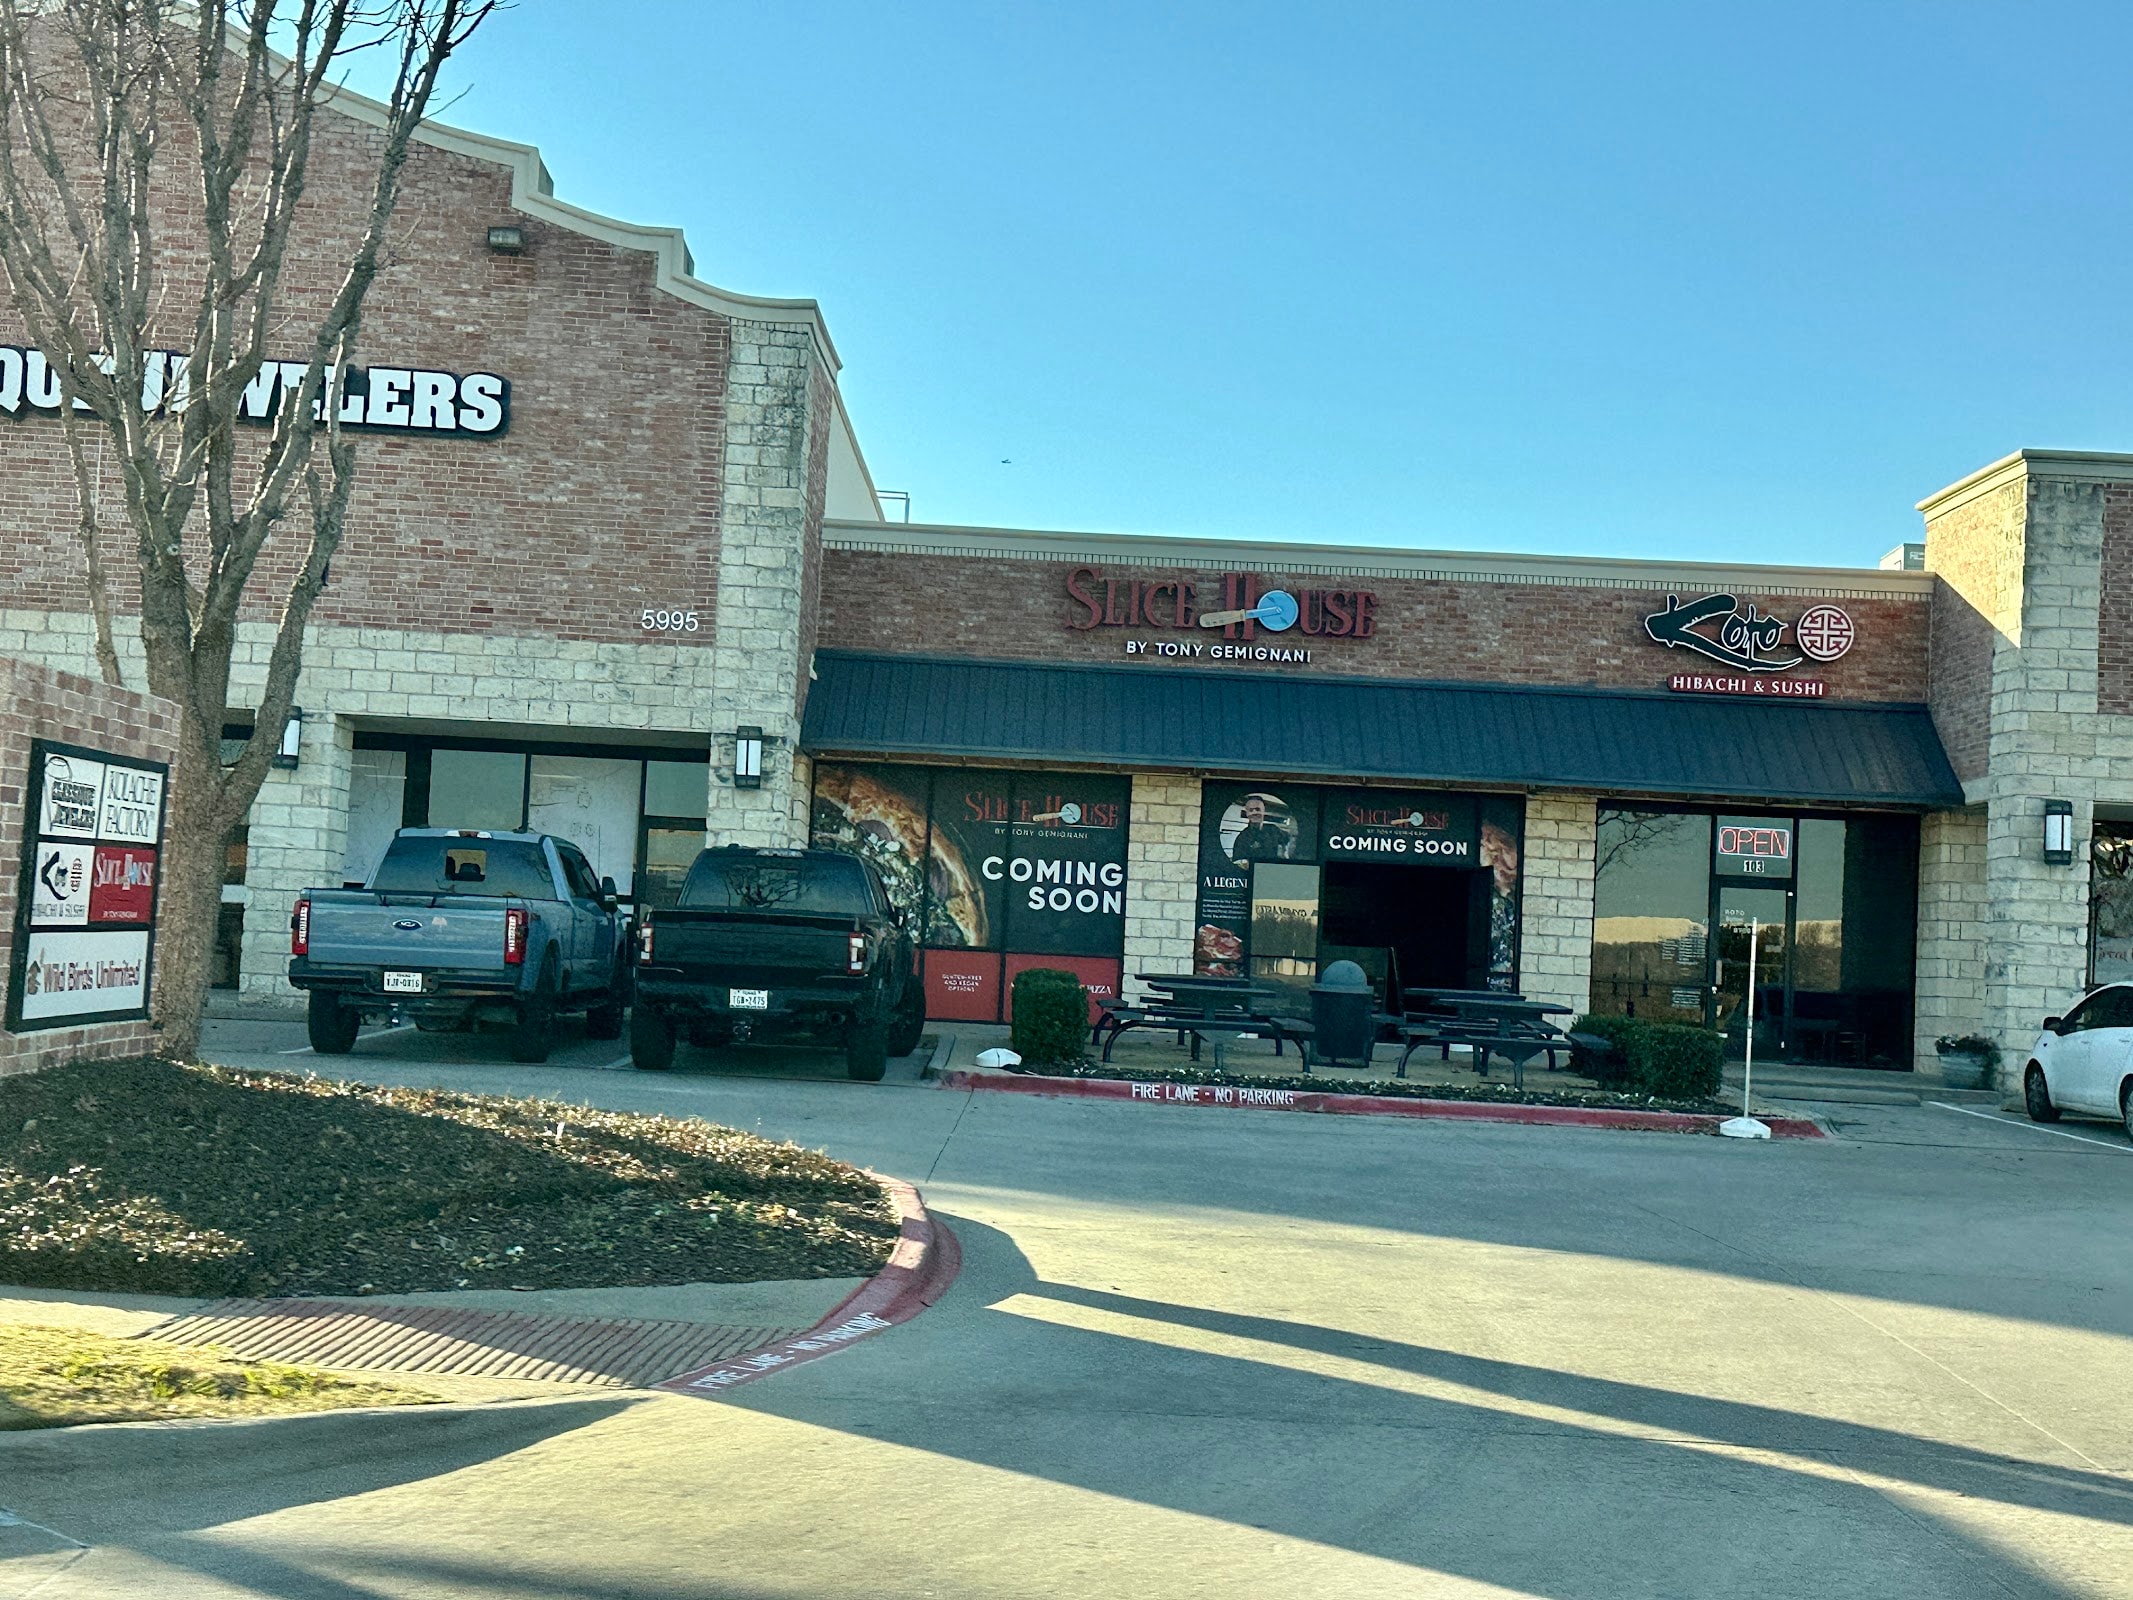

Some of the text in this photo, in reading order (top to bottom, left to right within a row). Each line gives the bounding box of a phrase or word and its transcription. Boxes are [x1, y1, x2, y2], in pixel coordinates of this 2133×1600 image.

[1065, 566, 1380, 641] SLICE HOUSE
[641, 609, 699, 632] 5995
[1126, 640, 1311, 664] BY TONY GEMIGNANI
[1672, 675, 1824, 696] HIBACHI & SUSHI
[1329, 835, 1468, 856] COMING SOON
[1721, 828, 1787, 857] OPEN
[982, 855, 1124, 887] COMING
[1203, 876, 1212, 888] A
[1028, 885, 1122, 915] SOON
[1132, 1083, 1160, 1099] FIRE
[1166, 1086, 1200, 1102] LANE
[1215, 1088, 1233, 1103] NO
[1239, 1089, 1294, 1106] PARKING
